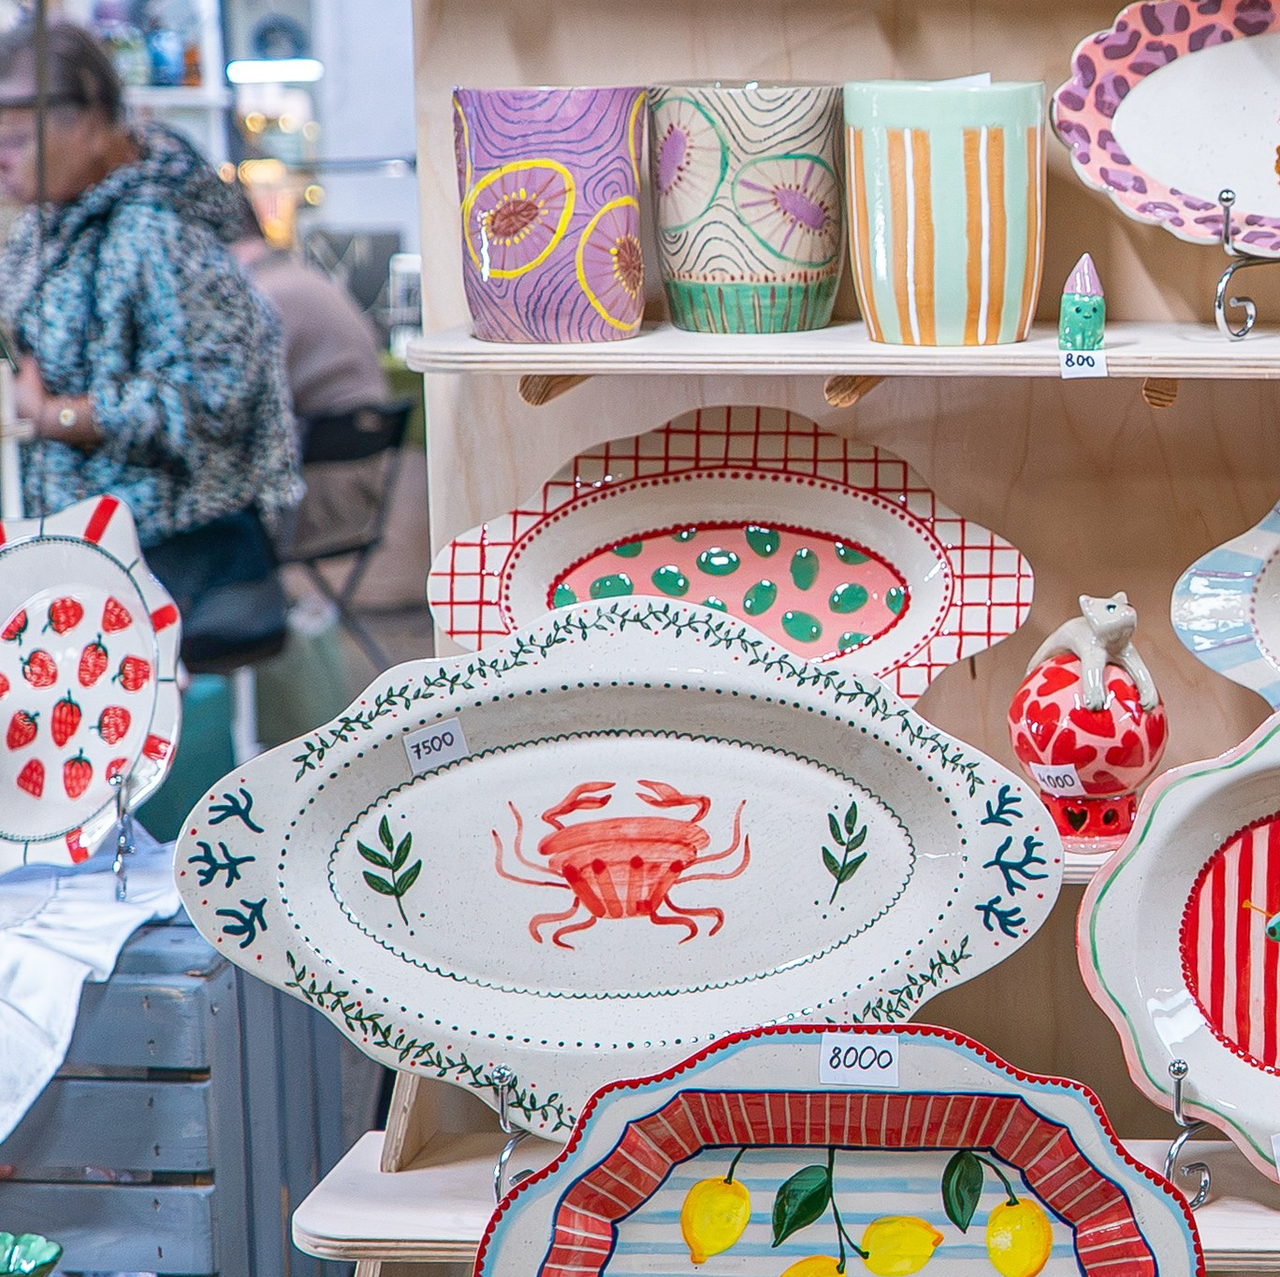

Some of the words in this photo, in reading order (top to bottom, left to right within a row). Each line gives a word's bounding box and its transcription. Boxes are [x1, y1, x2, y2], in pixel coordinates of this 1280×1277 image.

[1065, 353, 1096, 368] 800
[410, 731, 454, 760] 7500
[1038, 772, 1075, 789] 4000
[829, 1045, 893, 1069] 8000
